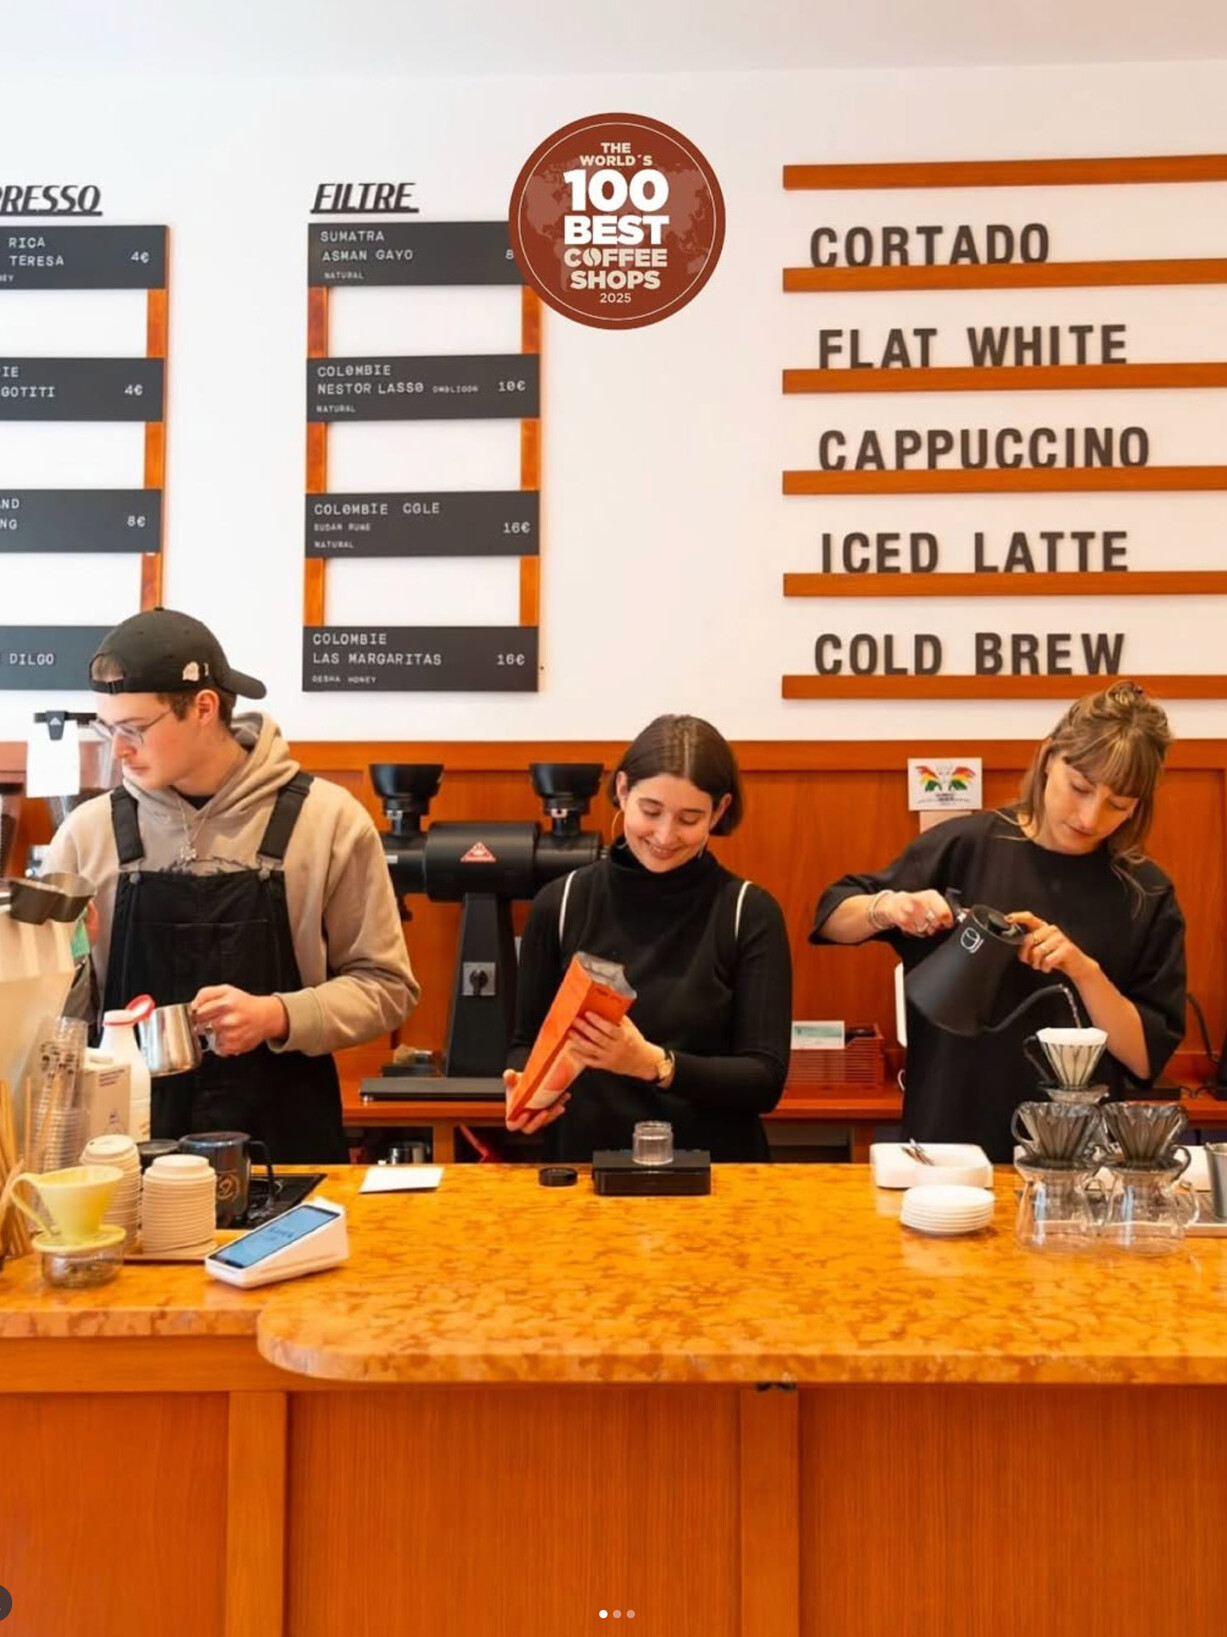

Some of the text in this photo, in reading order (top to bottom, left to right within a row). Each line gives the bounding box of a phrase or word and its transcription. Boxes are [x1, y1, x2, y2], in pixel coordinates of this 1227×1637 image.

[0, 184, 103, 216] RESSO
[309, 182, 420, 214] FILTRE
[8, 237, 46, 249] RICA
[320, 230, 385, 243] SUMATRA
[810, 223, 1049, 268] CORTADO
[9, 254, 64, 267] TERESA
[130, 251, 149, 264] 4€
[321, 248, 413, 262] ASMAN GAYO
[323, 271, 364, 280] NATURAL
[819, 324, 1127, 369] FLAT WHITE
[0, 366, 19, 378] IE
[0, 386, 55, 398] GOTITI
[124, 384, 143, 396] 4€
[317, 382, 372, 395] NESTOR
[498, 380, 526, 392] 10€
[315, 404, 356, 413] NATURAL
[819, 426, 1149, 470] CAPPUCCINO
[0, 498, 20, 510] ND
[402, 501, 440, 515] CGLE
[126, 515, 146, 528] 8€
[503, 521, 531, 534] 16€
[314, 540, 354, 549] NATURAL
[822, 531, 1128, 574] ICED LATTE
[312, 632, 387, 646] COLOMBIE
[9, 652, 55, 666] DILGO
[313, 652, 442, 666] LAS MARGARITAS
[497, 653, 526, 666] 16€
[814, 632, 1125, 675] COLD BREW
